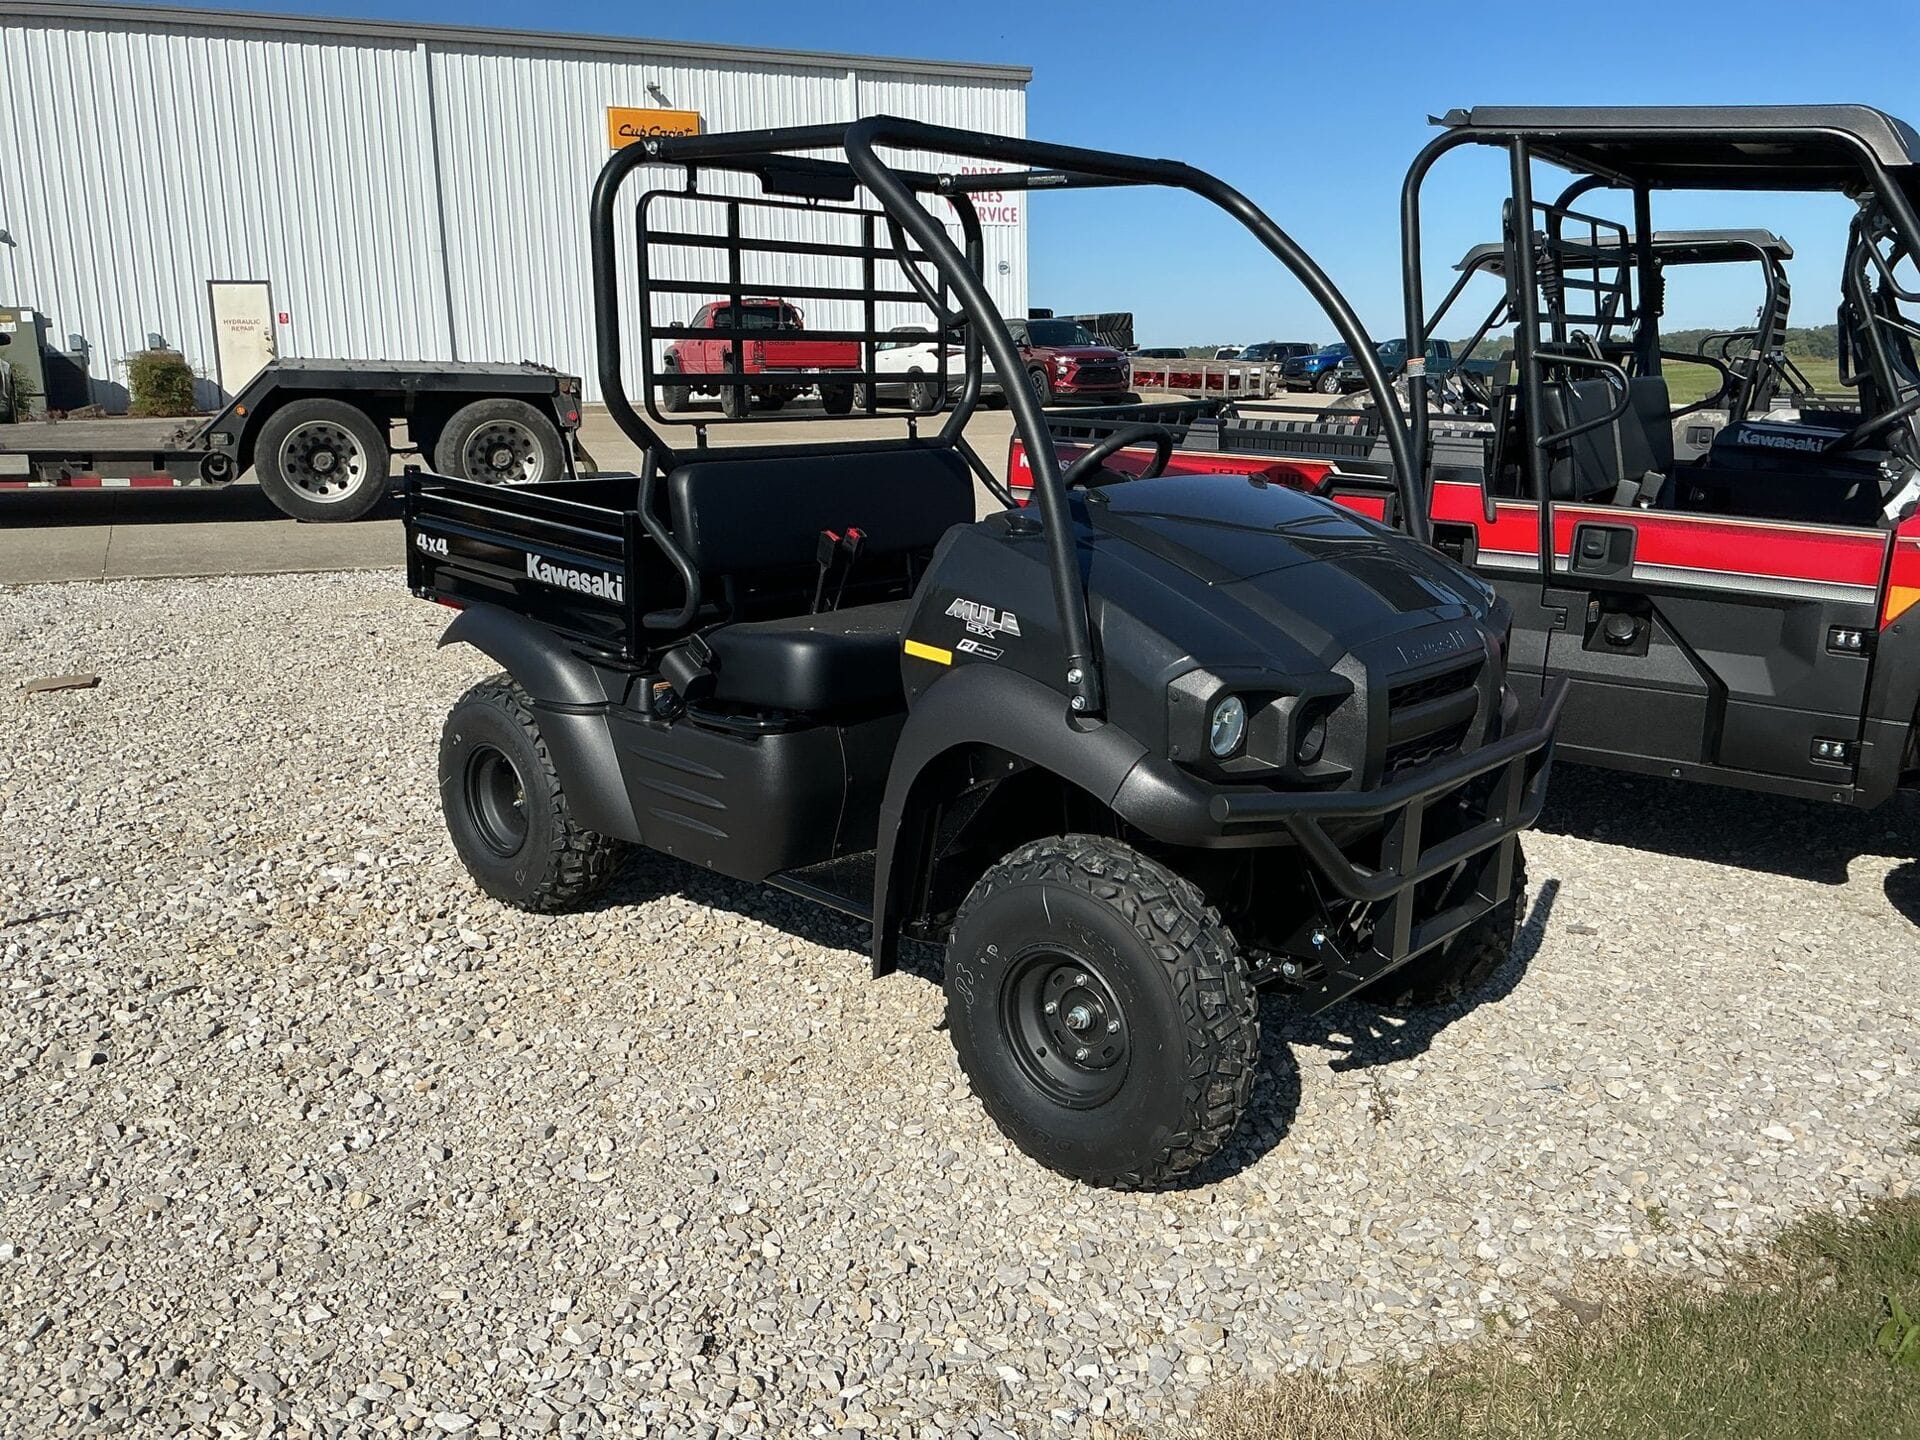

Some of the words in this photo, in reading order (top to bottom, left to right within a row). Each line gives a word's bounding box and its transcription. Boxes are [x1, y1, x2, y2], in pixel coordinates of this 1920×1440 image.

[619, 124, 646, 137] Cub
[971, 191, 1003, 203] ALES
[976, 206, 1017, 222] RVICE
[1737, 430, 1824, 452] Kawasaki
[416, 532, 448, 556] 4x4
[526, 553, 624, 602] Kawasaki
[945, 597, 1021, 637] MULE
[966, 622, 996, 640] SX
[959, 641, 976, 650] FI
